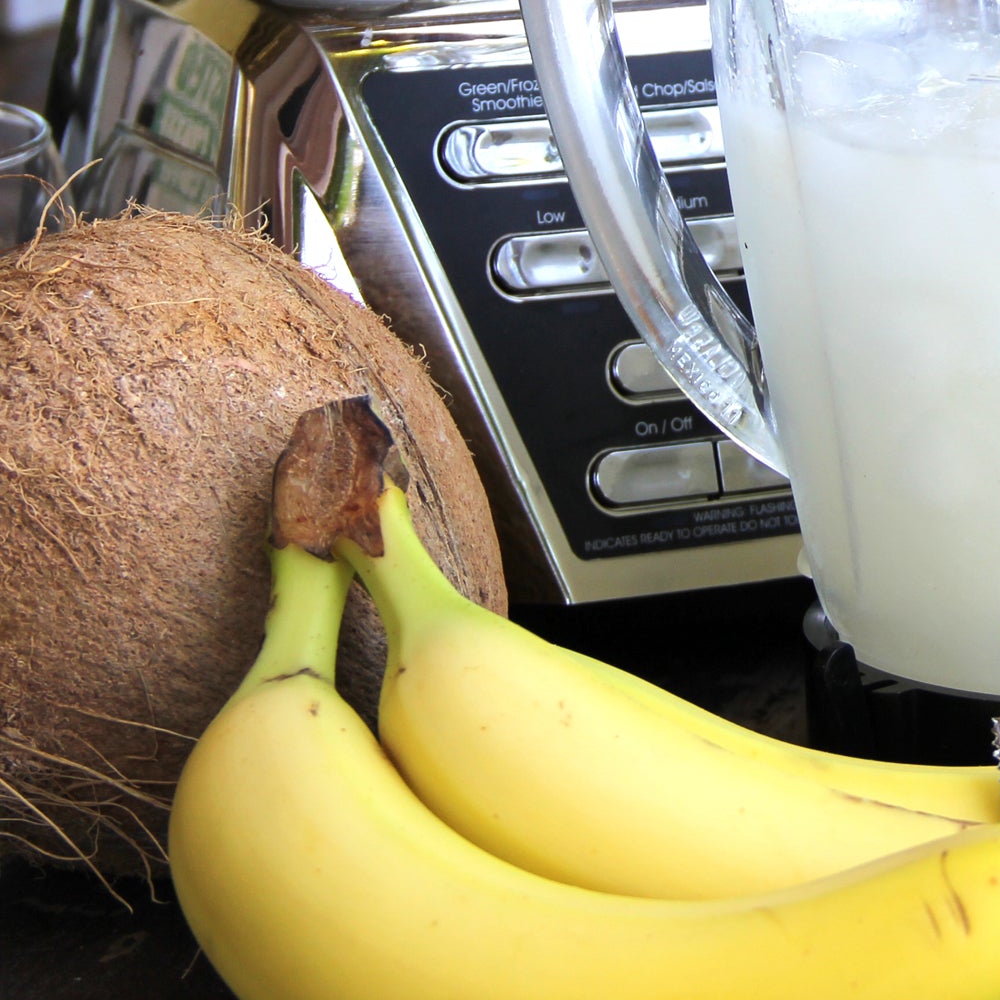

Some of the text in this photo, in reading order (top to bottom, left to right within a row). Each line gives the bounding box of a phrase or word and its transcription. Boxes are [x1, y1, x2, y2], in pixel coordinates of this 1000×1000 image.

[458, 79, 539, 97] Green/Froz
[642, 79, 718, 98] Chop/Sals
[536, 210, 565, 225] Low
[635, 420, 659, 436] On
[670, 417, 693, 432] Off
[585, 534, 638, 550] INDICATES
[640, 531, 674, 545] READY
[677, 527, 690, 539] TO
[692, 521, 737, 538] OPERATE
[740, 519, 758, 532] DO
[760, 516, 781, 529] NOT
